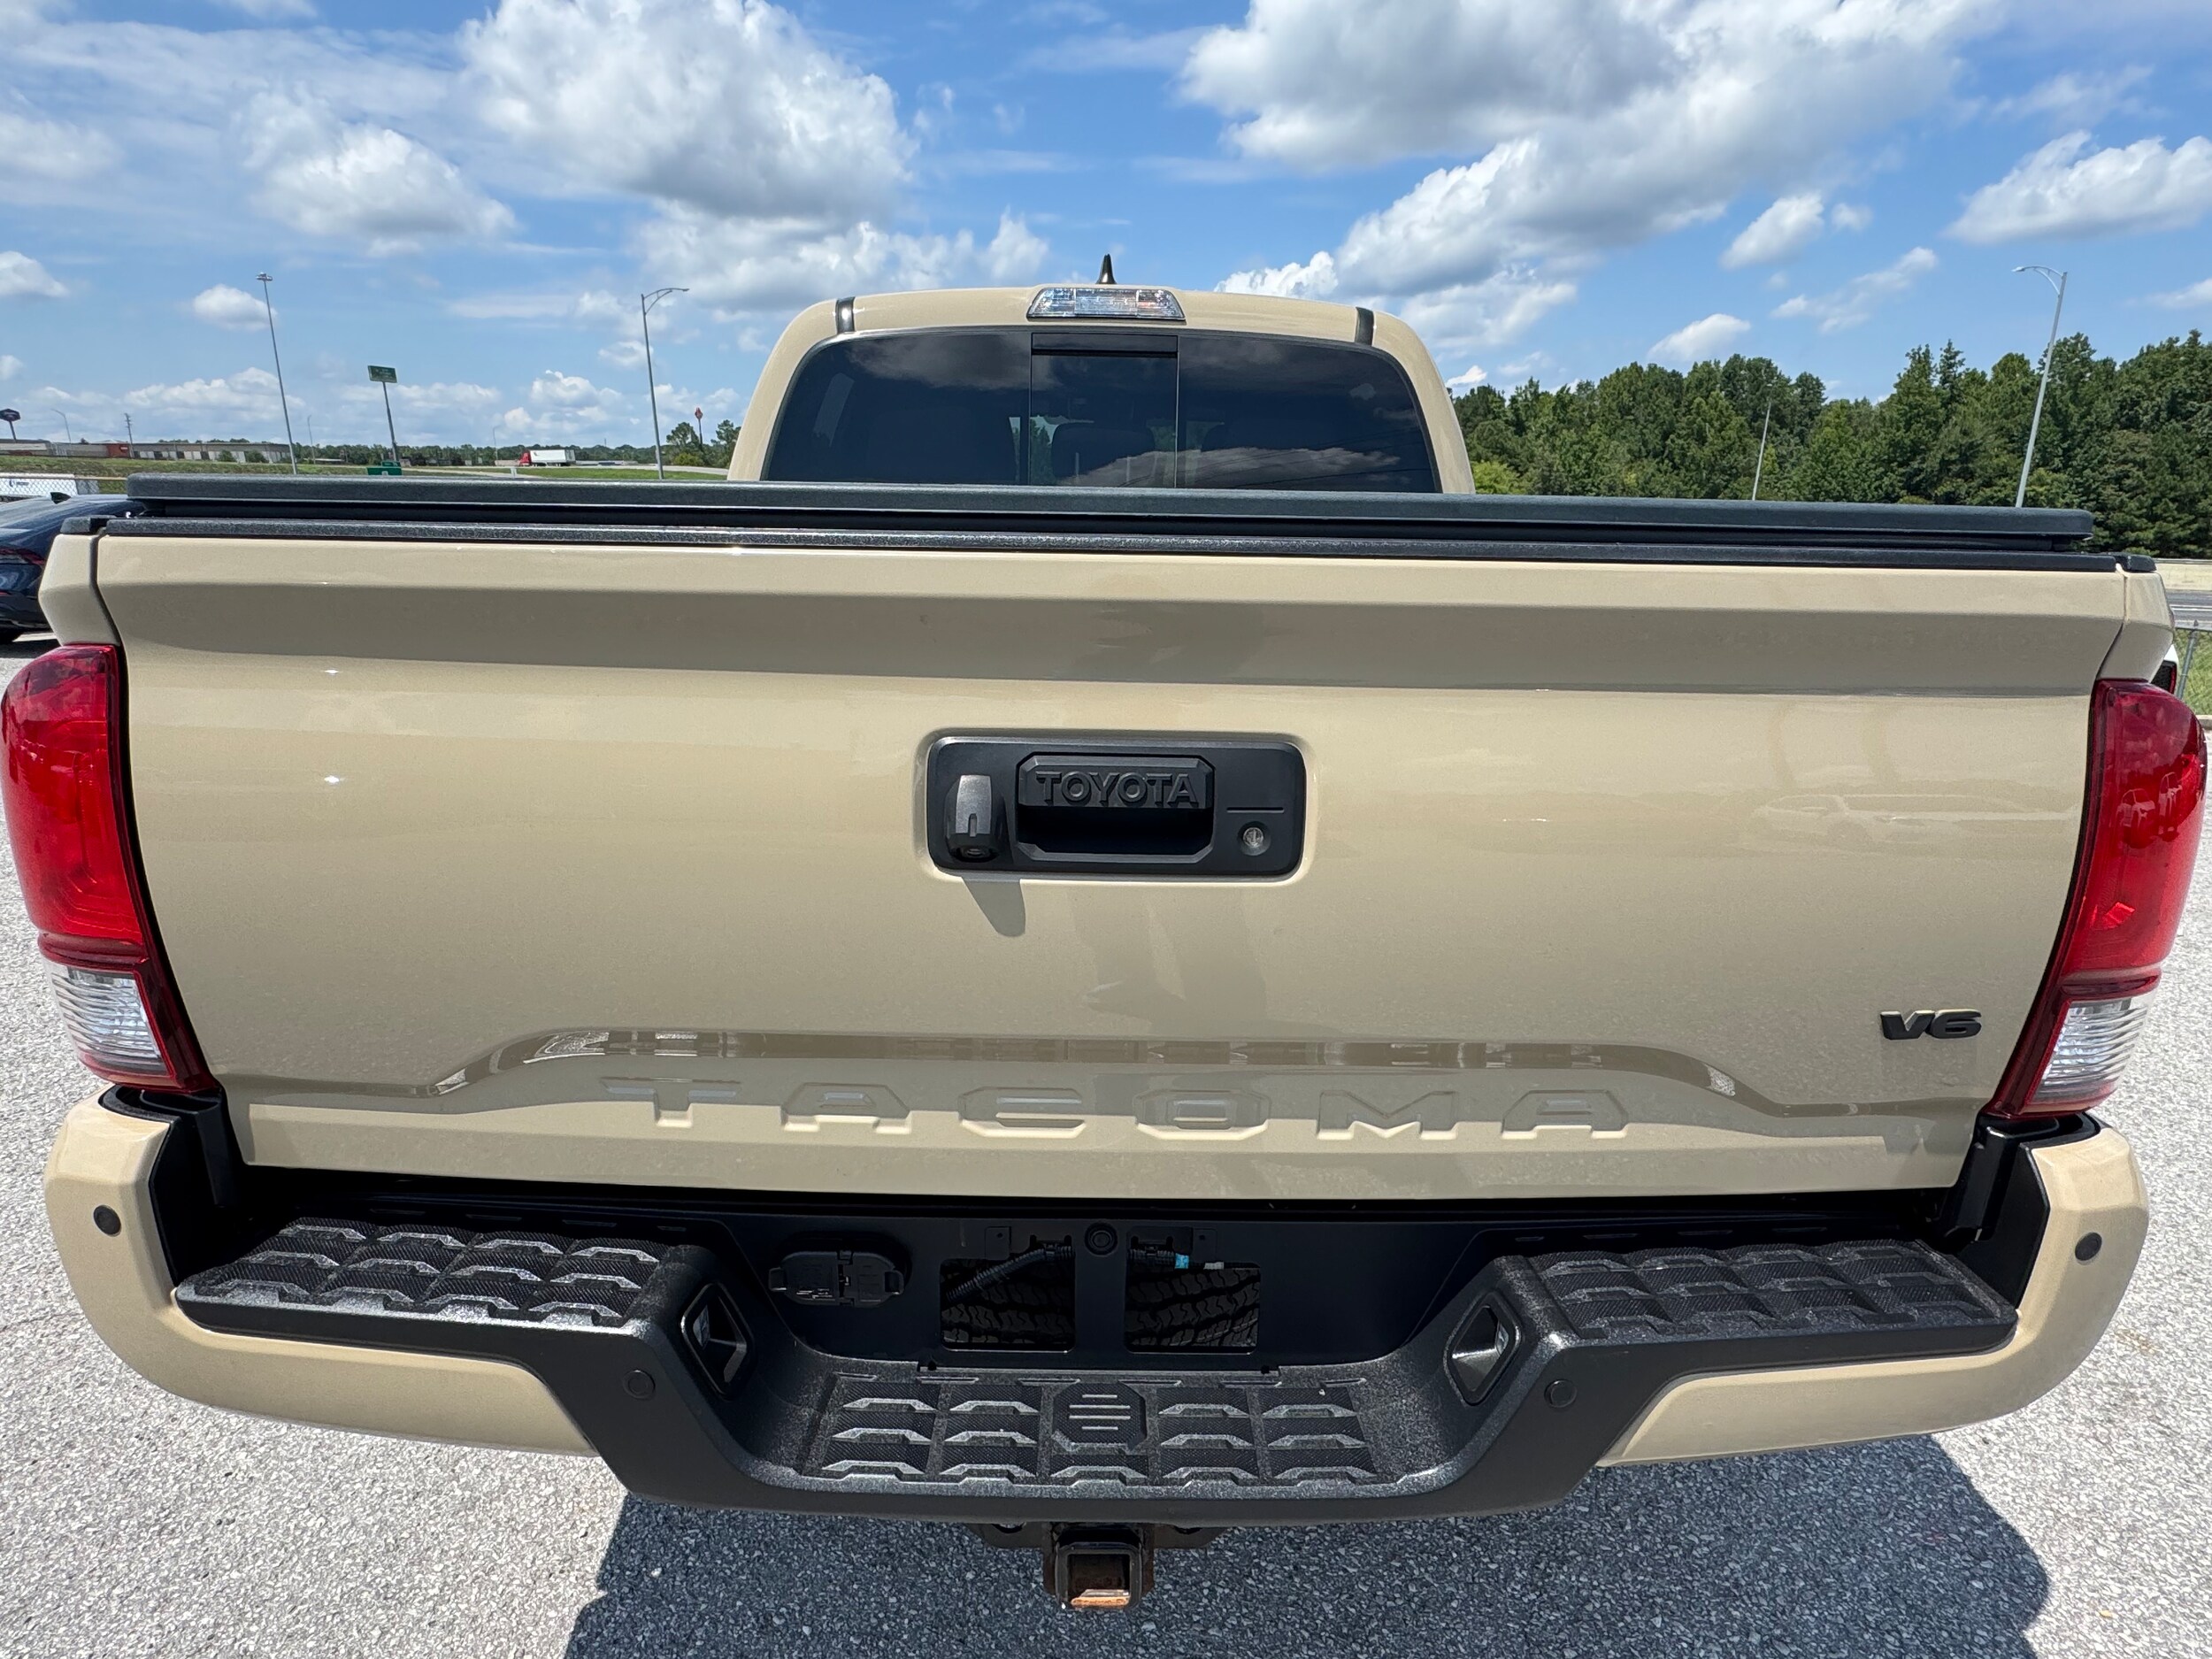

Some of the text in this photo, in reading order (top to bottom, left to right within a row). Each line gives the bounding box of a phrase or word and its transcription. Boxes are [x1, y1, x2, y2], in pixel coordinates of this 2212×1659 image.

[1034, 770, 1199, 808] TOYOTA
[1879, 1008, 1982, 1041] V6
[599, 1076, 1629, 1141] TACOMA
